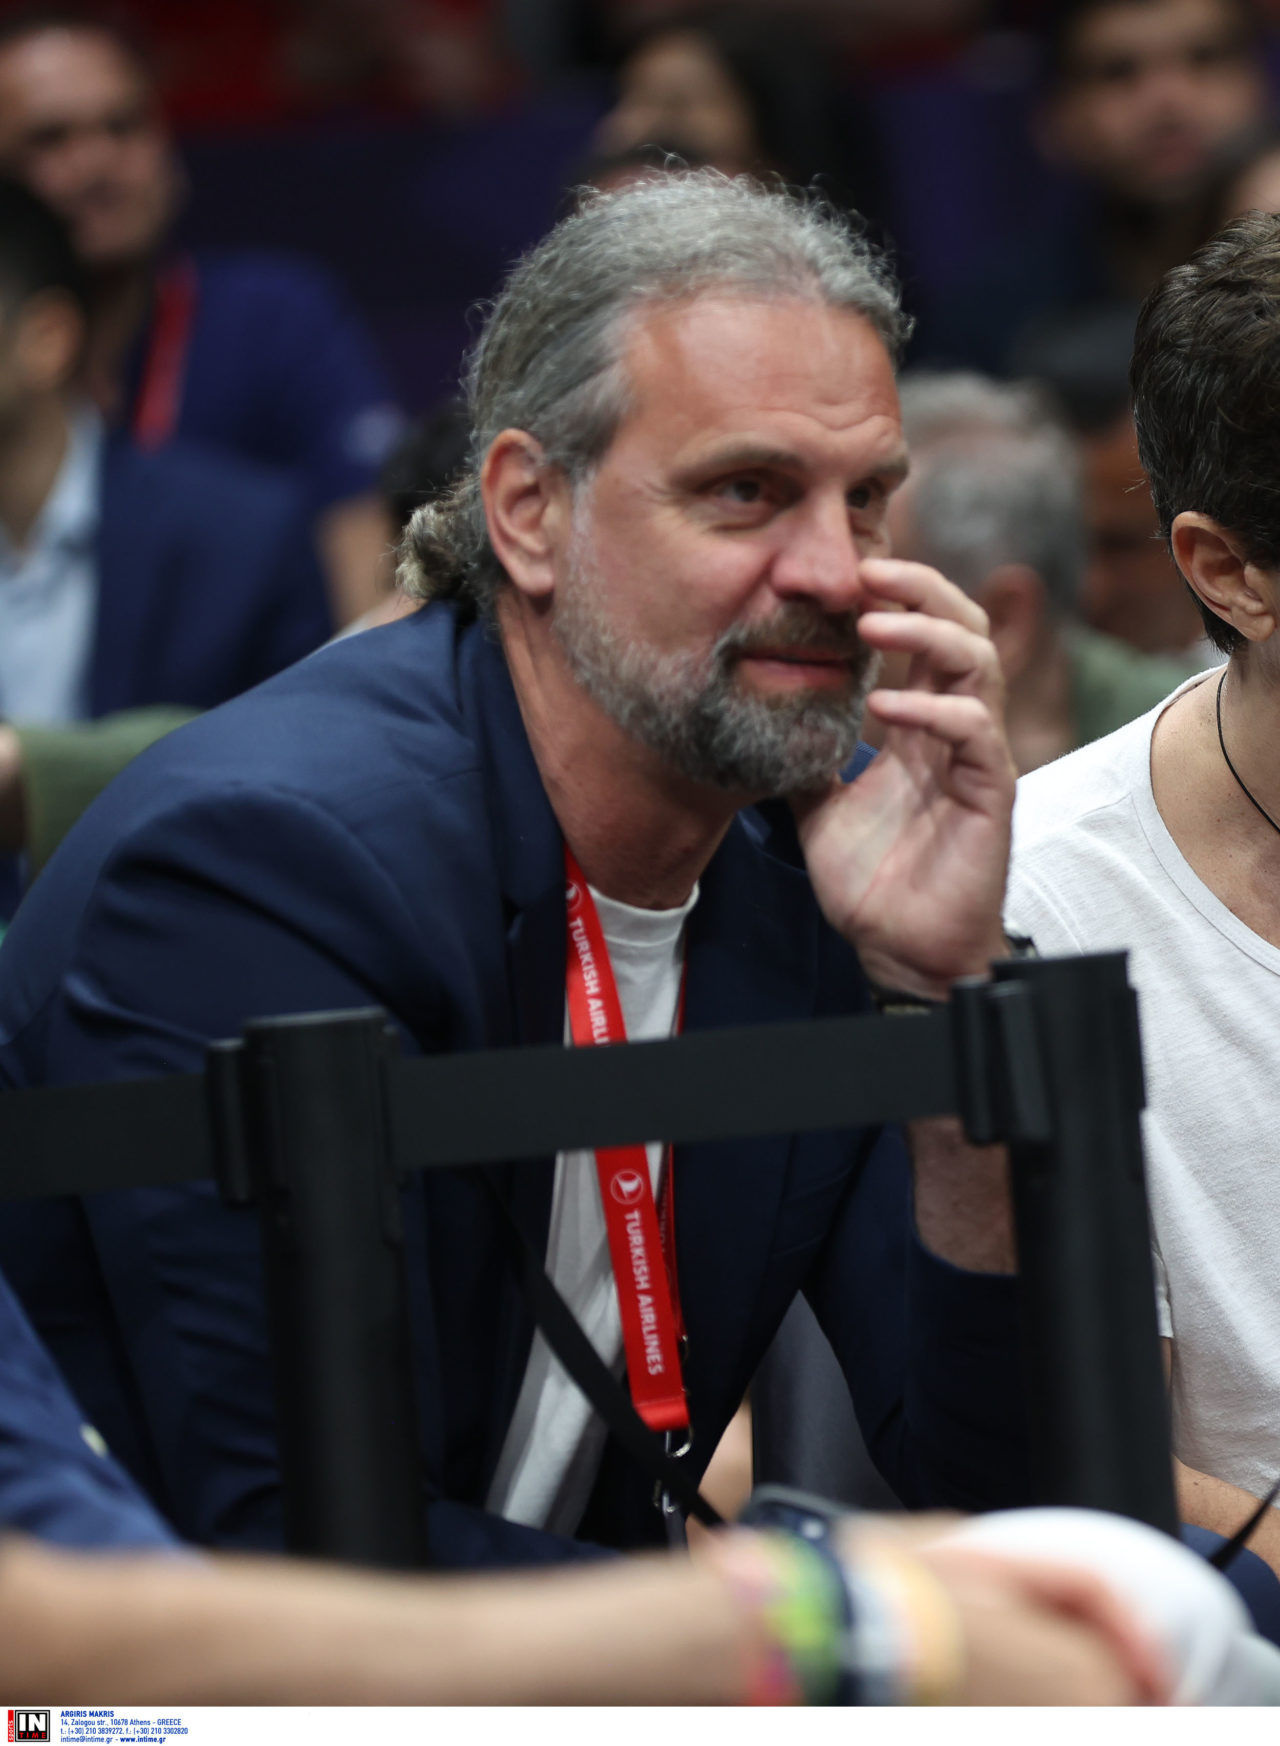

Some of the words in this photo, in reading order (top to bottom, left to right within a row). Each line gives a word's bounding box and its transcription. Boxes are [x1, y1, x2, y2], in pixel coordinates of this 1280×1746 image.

[568, 916, 601, 995] TURKISH
[586, 997, 611, 1046] AIRLI
[623, 1209, 651, 1290] TURKISH
[637, 1293, 665, 1376] AIRLINES
